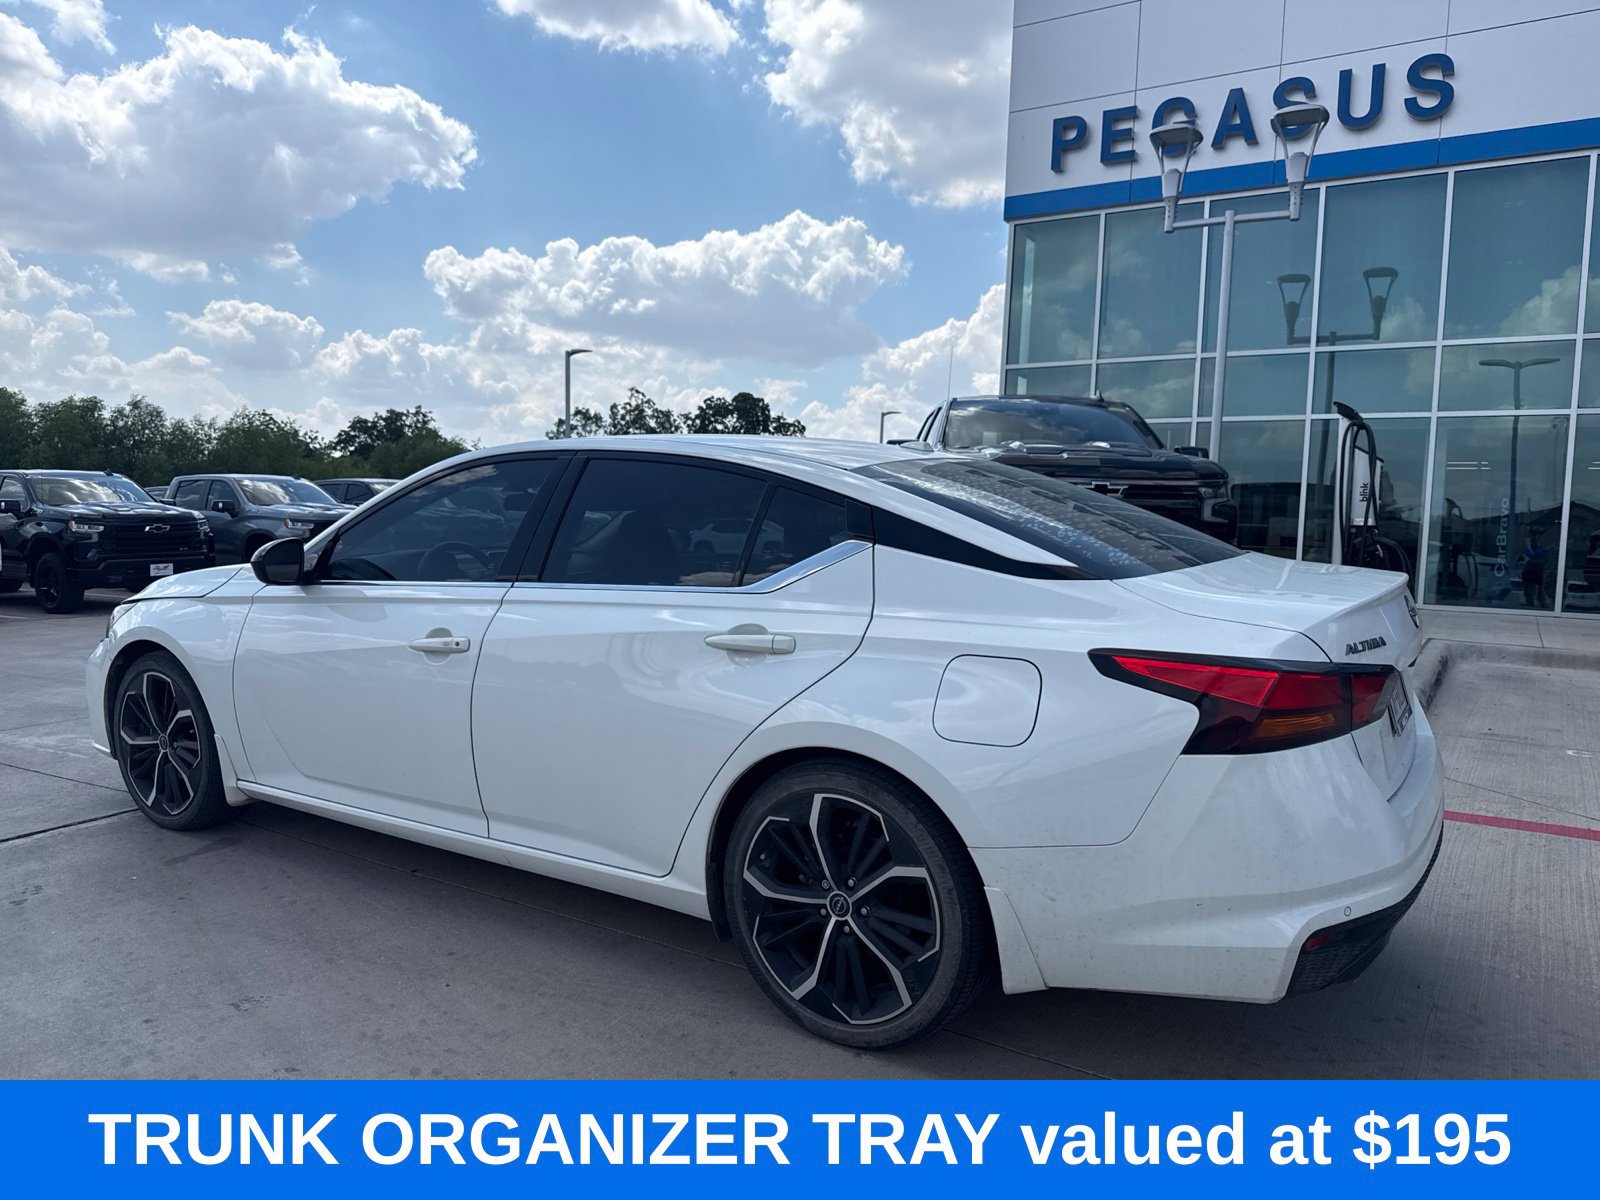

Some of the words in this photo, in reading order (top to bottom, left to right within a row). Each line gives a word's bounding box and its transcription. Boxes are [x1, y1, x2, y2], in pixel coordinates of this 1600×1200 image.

[1051, 53, 1456, 174] PEGASUS
[1359, 482, 1369, 502] blink
[1345, 636, 1387, 656] ALTIMA
